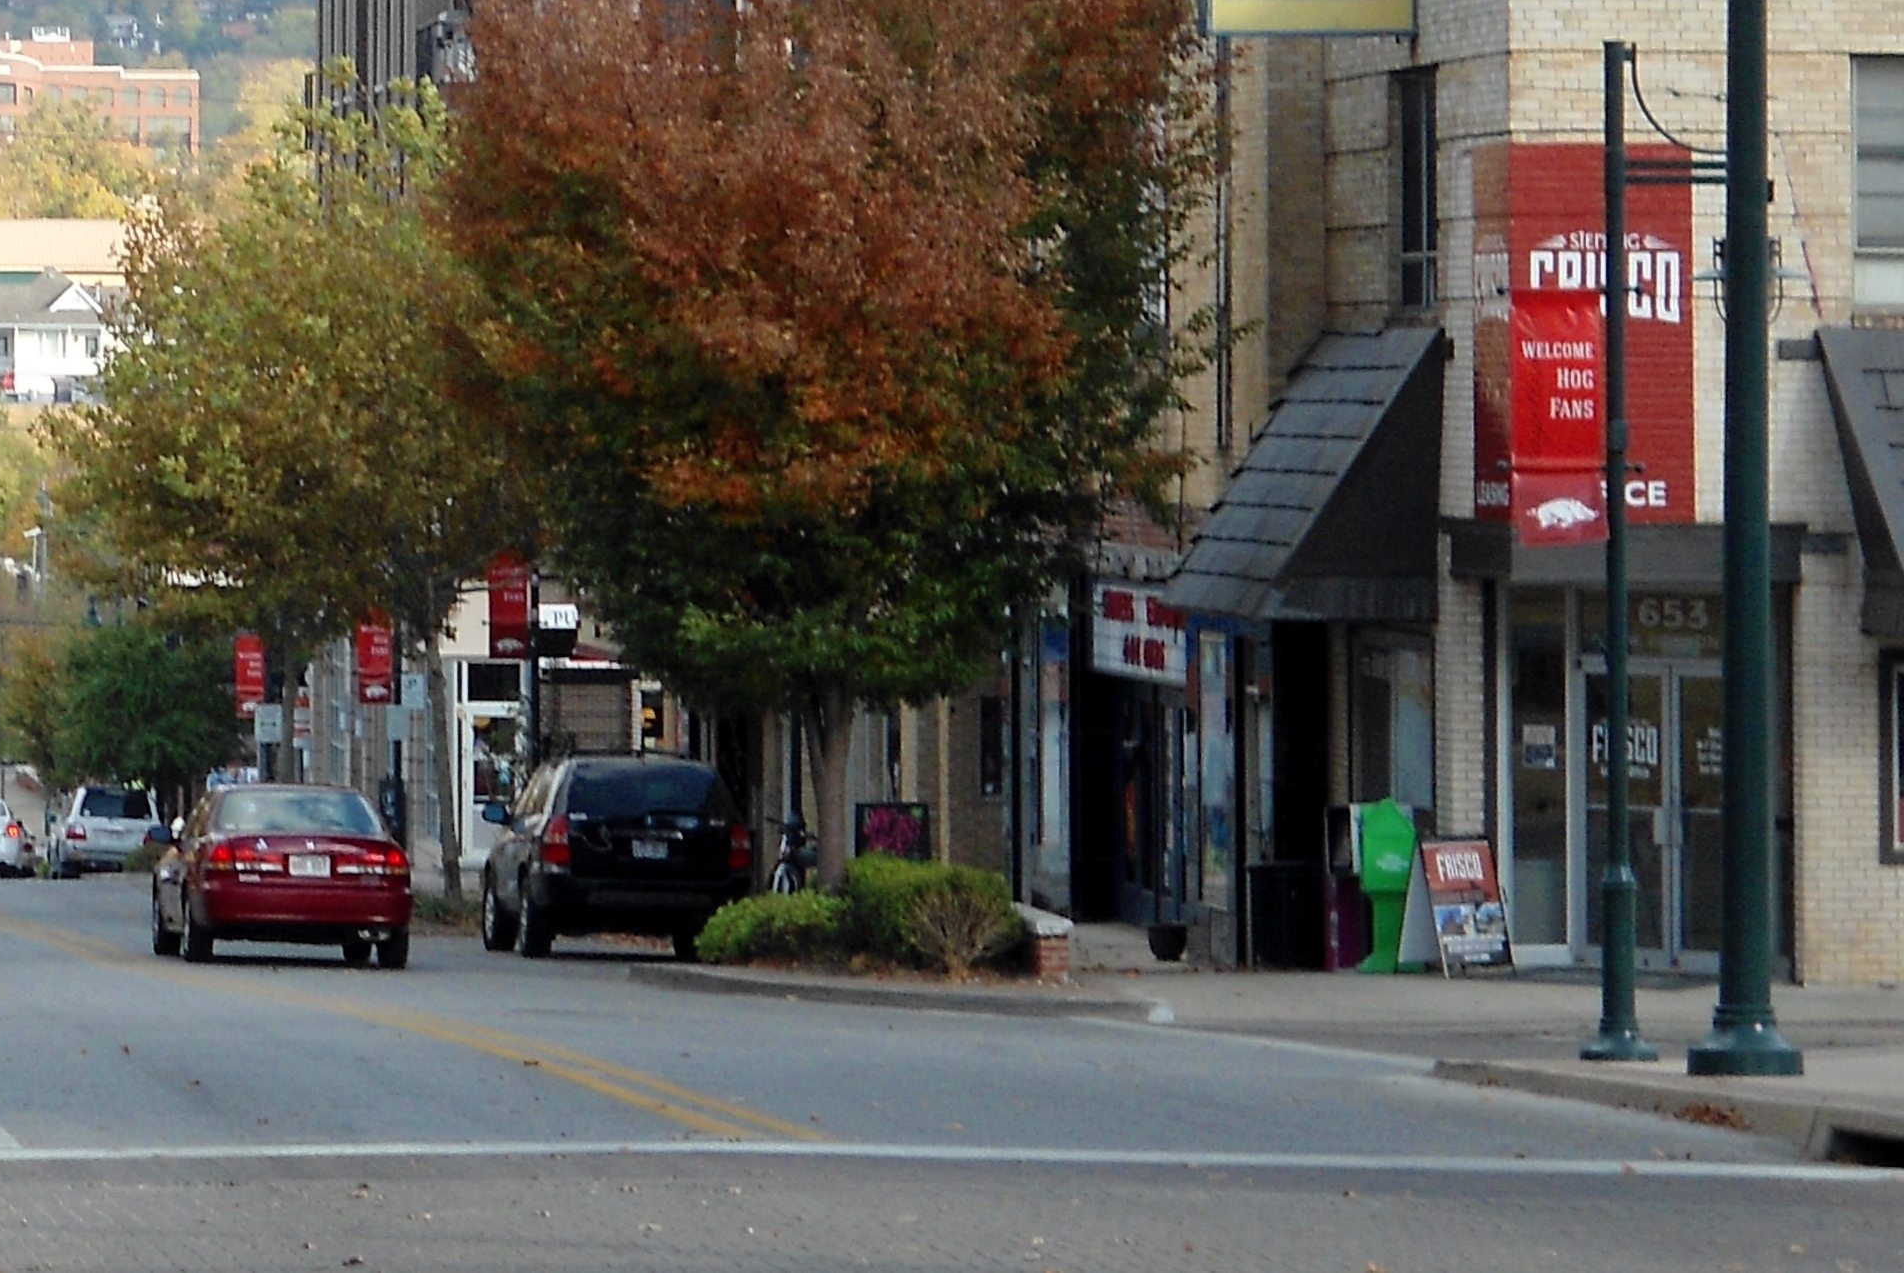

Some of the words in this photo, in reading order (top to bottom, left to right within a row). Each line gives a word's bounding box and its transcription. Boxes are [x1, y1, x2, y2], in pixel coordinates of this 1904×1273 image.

[1522, 340, 1594, 359] WELCOME
[1557, 367, 1594, 389] HOG
[1550, 396, 1594, 419] FANS
[1638, 598, 1708, 628] 653
[1436, 851, 1484, 883] FRISCO
